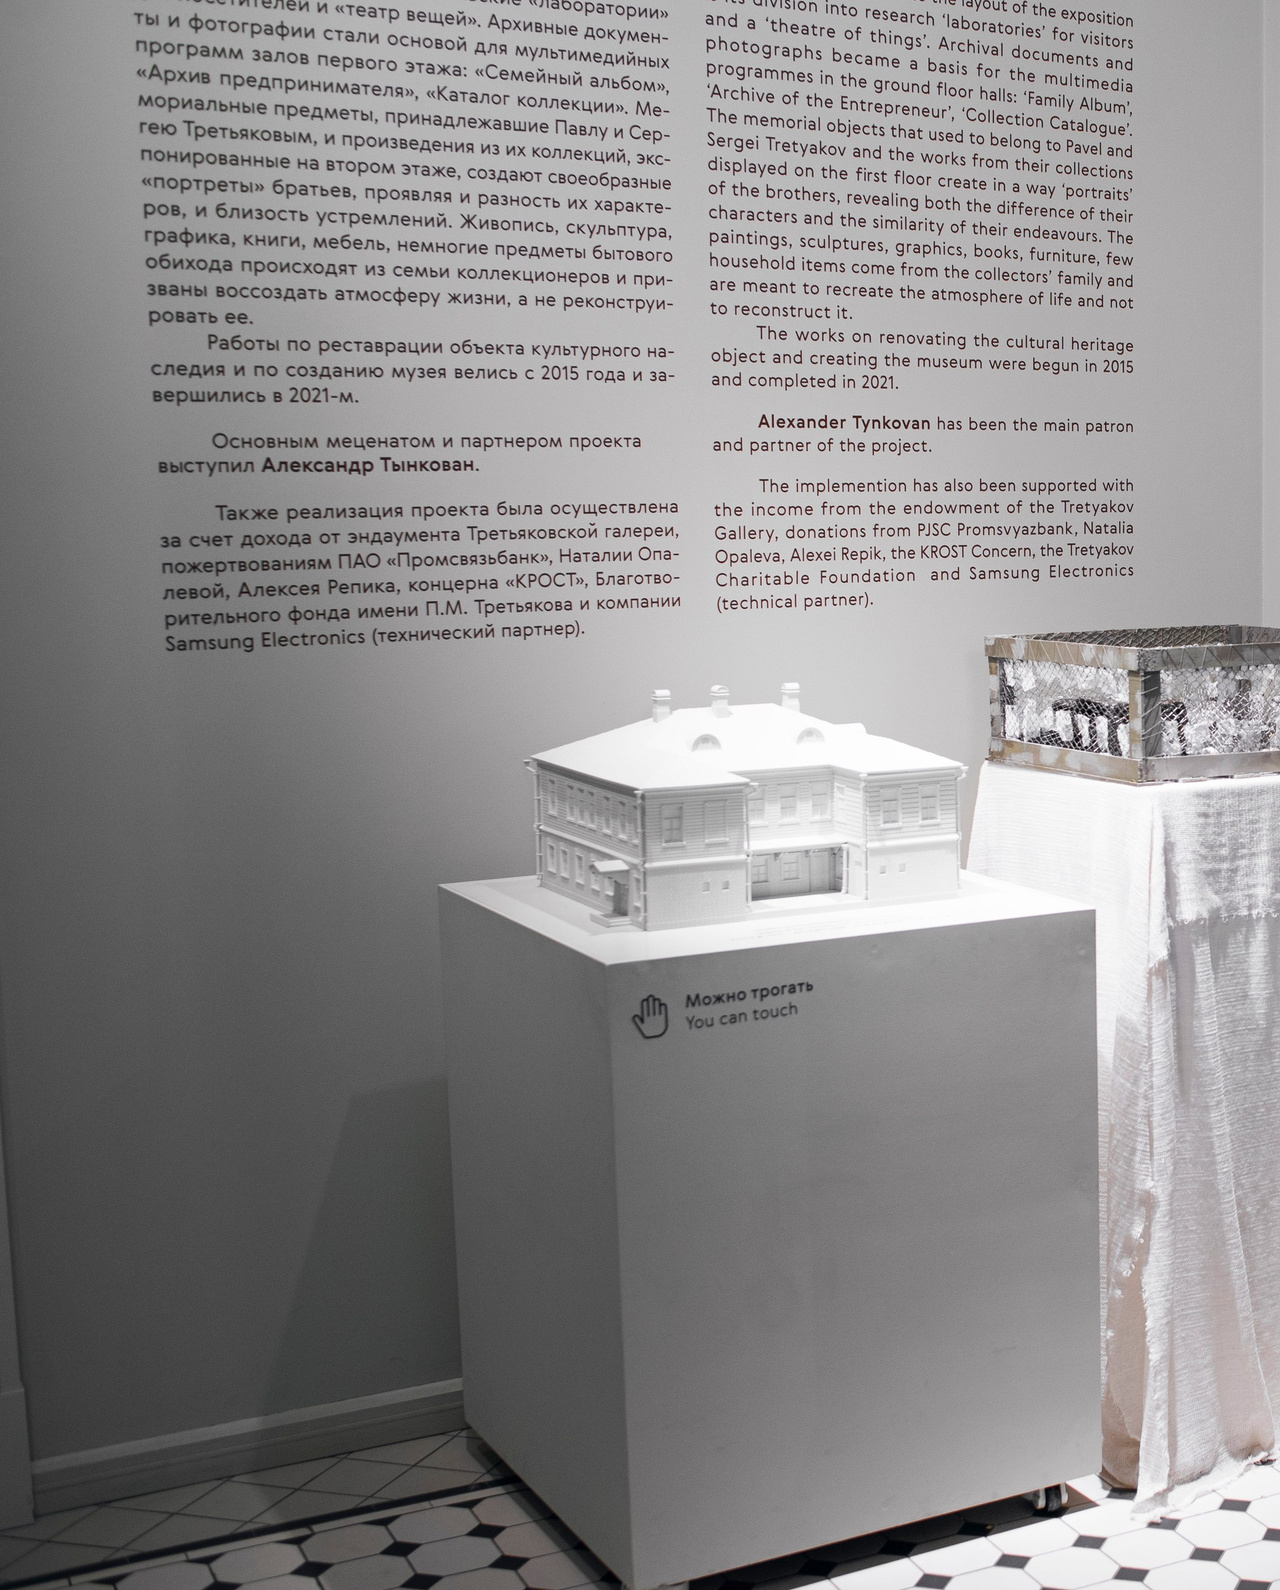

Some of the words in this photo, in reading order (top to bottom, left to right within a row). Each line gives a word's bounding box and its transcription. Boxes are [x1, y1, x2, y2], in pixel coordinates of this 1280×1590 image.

[707, 63, 813, 83] programmes
[820, 69, 833, 85] in
[841, 72, 867, 88] the
[874, 79, 930, 95] ground
[937, 81, 973, 99] floor
[980, 86, 1016, 104] halls:
[208, 334, 279, 351] Работы
[288, 339, 311, 351] по
[319, 340, 442, 357] реставрации
[450, 339, 524, 356] объекта
[532, 344, 640, 361] культурного
[648, 347, 674, 358] на-
[151, 364, 225, 378] следия
[234, 365, 245, 377] и
[254, 365, 278, 377] по
[286, 365, 383, 380] созданию
[392, 367, 446, 382] музея
[455, 367, 517, 380] велись
[525, 368, 534, 380] с
[542, 365, 579, 381] 2015
[587, 369, 625, 383] года
[633, 371, 642, 382] и
[650, 371, 674, 382] за-
[153, 390, 266, 406] вершились
[273, 391, 282, 403] в
[289, 386, 358, 404] 2021-м.
[758, 414, 846, 429] Alexander
[852, 415, 930, 434] Tynkovan
[938, 416, 962, 430] has
[969, 417, 1006, 431] been
[1013, 417, 1037, 432] the
[1044, 421, 1079, 432] main
[1086, 421, 1133, 436] patron
[212, 433, 318, 449] Основным
[327, 437, 435, 451] меценатом
[443, 437, 453, 448] и
[461, 436, 562, 451] партнером
[570, 436, 641, 451] проекта
[713, 436, 743, 451] and
[750, 439, 811, 455] partner
[817, 438, 833, 452] of
[840, 438, 865, 453] the
[872, 438, 931, 456] project.
[159, 461, 254, 477] выступил
[262, 457, 374, 476] Александр
[380, 456, 479, 472] Тынкован.
[759, 478, 789, 493] The
[796, 478, 906, 496] implemention
[914, 478, 938, 492] has
[945, 478, 973, 492] also
[980, 478, 1015, 492] been
[1022, 478, 1096, 496] supported
[1103, 478, 1133, 491] with
[715, 525, 778, 544] Gallery,
[786, 524, 866, 539] donations
[873, 523, 910, 537] from
[918, 522, 951, 537] PJSC
[958, 521, 1077, 540] Promsvyazbank,
[1084, 520, 1133, 535] Natalia
[717, 593, 797, 614] (technical
[804, 591, 873, 612] partner).
[166, 635, 254, 653] Samsung
[262, 629, 365, 648] Electronics
[373, 623, 494, 646] (технический
[502, 619, 584, 641] партнер).
[686, 990, 746, 1008] Можно
[751, 981, 813, 1002] трогать
[686, 1015, 714, 1030] You
[719, 1011, 747, 1026] can
[753, 1002, 798, 1021] touch
